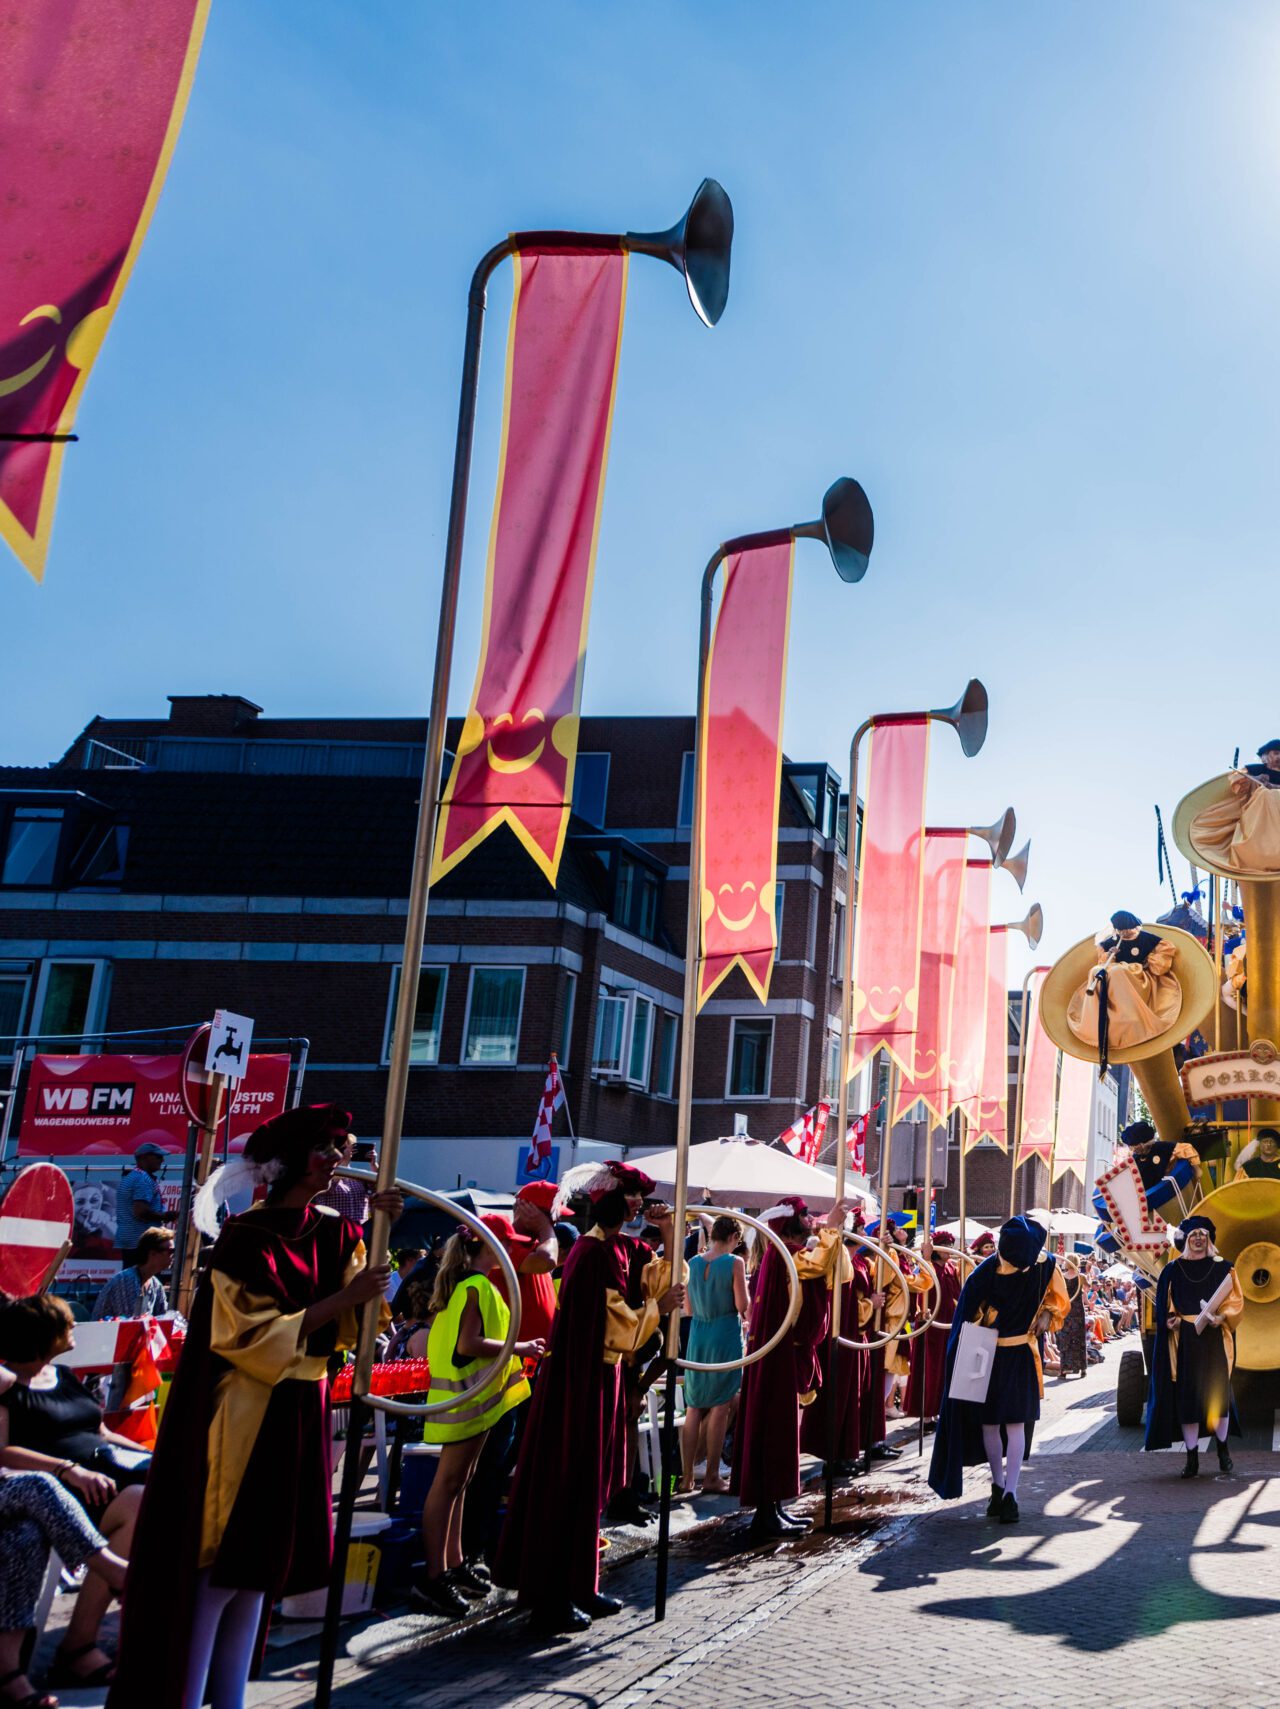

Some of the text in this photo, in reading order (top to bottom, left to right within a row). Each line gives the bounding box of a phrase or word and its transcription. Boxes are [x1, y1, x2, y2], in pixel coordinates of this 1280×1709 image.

[149, 1091, 275, 1103] VANA USTUS
[242, 1103, 261, 1114] FM
[34, 1116, 131, 1127] WAGENBOUWERS FM
